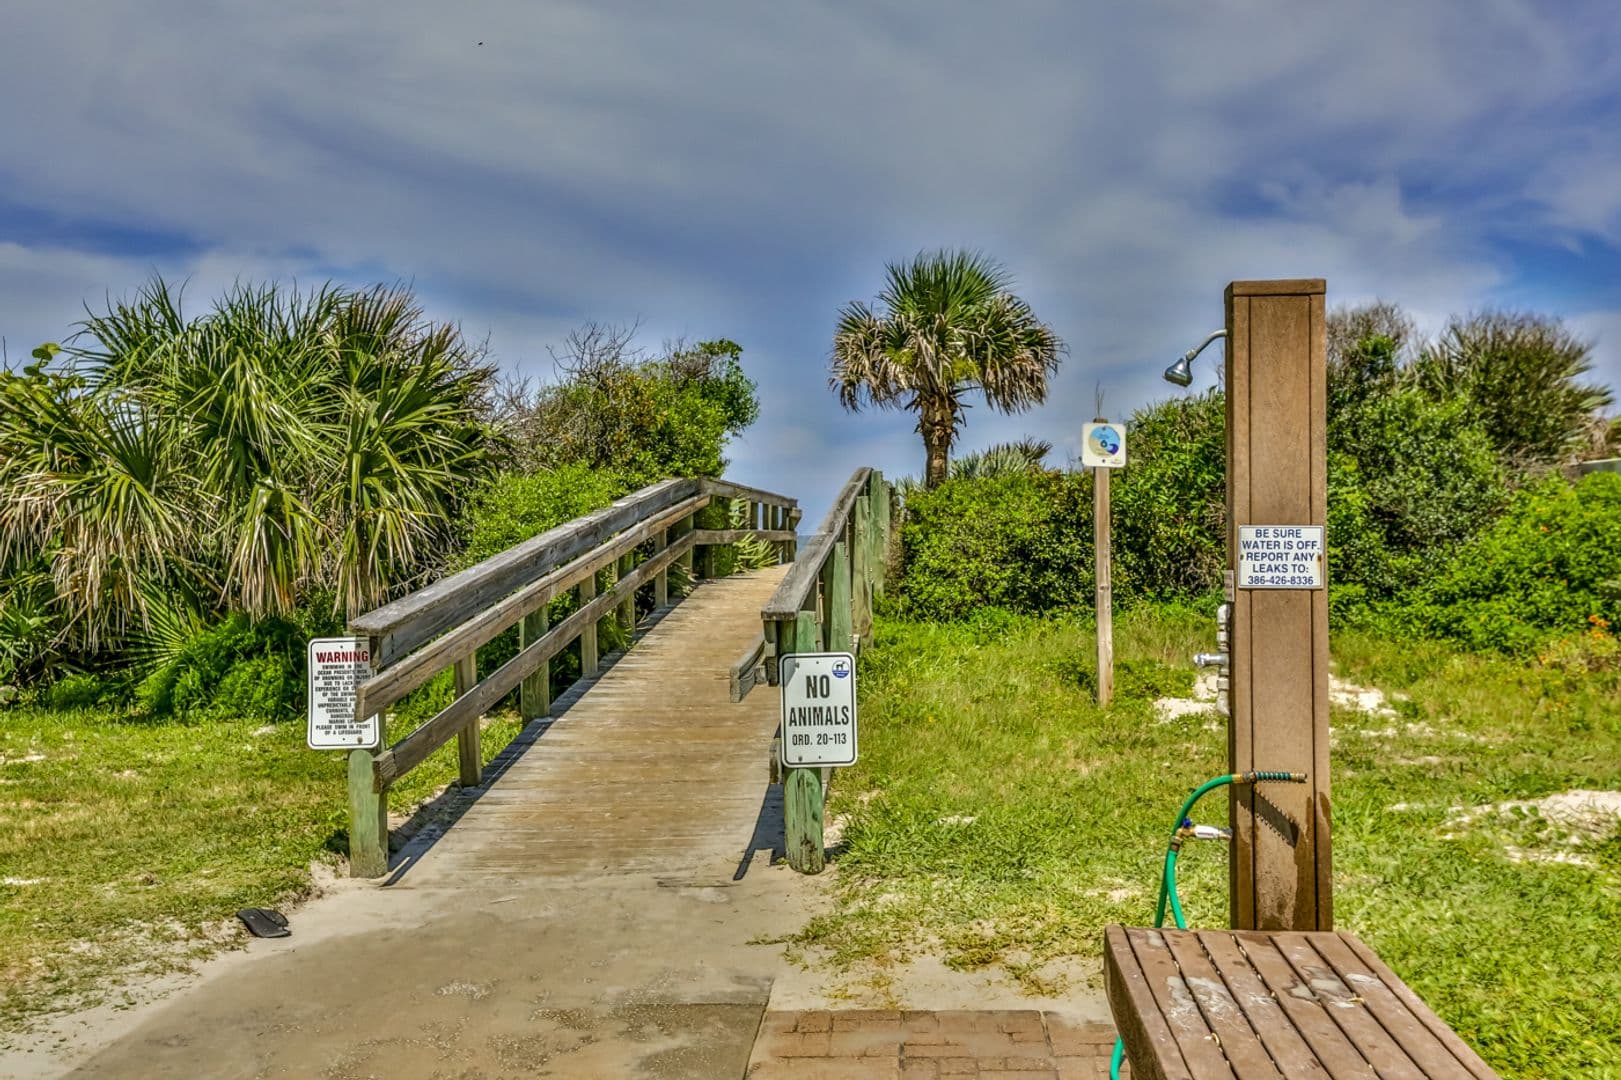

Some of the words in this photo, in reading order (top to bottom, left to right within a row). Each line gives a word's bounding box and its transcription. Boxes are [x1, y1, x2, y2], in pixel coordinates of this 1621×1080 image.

[1255, 529, 1269, 538] BE
[1273, 529, 1302, 538] SURE
[1242, 540, 1280, 550] WATER
[1284, 540, 1294, 550] IS
[1246, 552, 1290, 561] REPORT
[1293, 552, 1315, 561] ANY
[1252, 564, 1288, 573] LEAKS
[1291, 564, 1309, 573] TO:
[1248, 576, 1314, 584] 386-426-8336
[316, 650, 368, 663] WARNING
[806, 674, 830, 699] NO
[789, 705, 850, 727] ANIMALS
[792, 734, 813, 746] ORD.
[816, 733, 847, 745] 20-113
